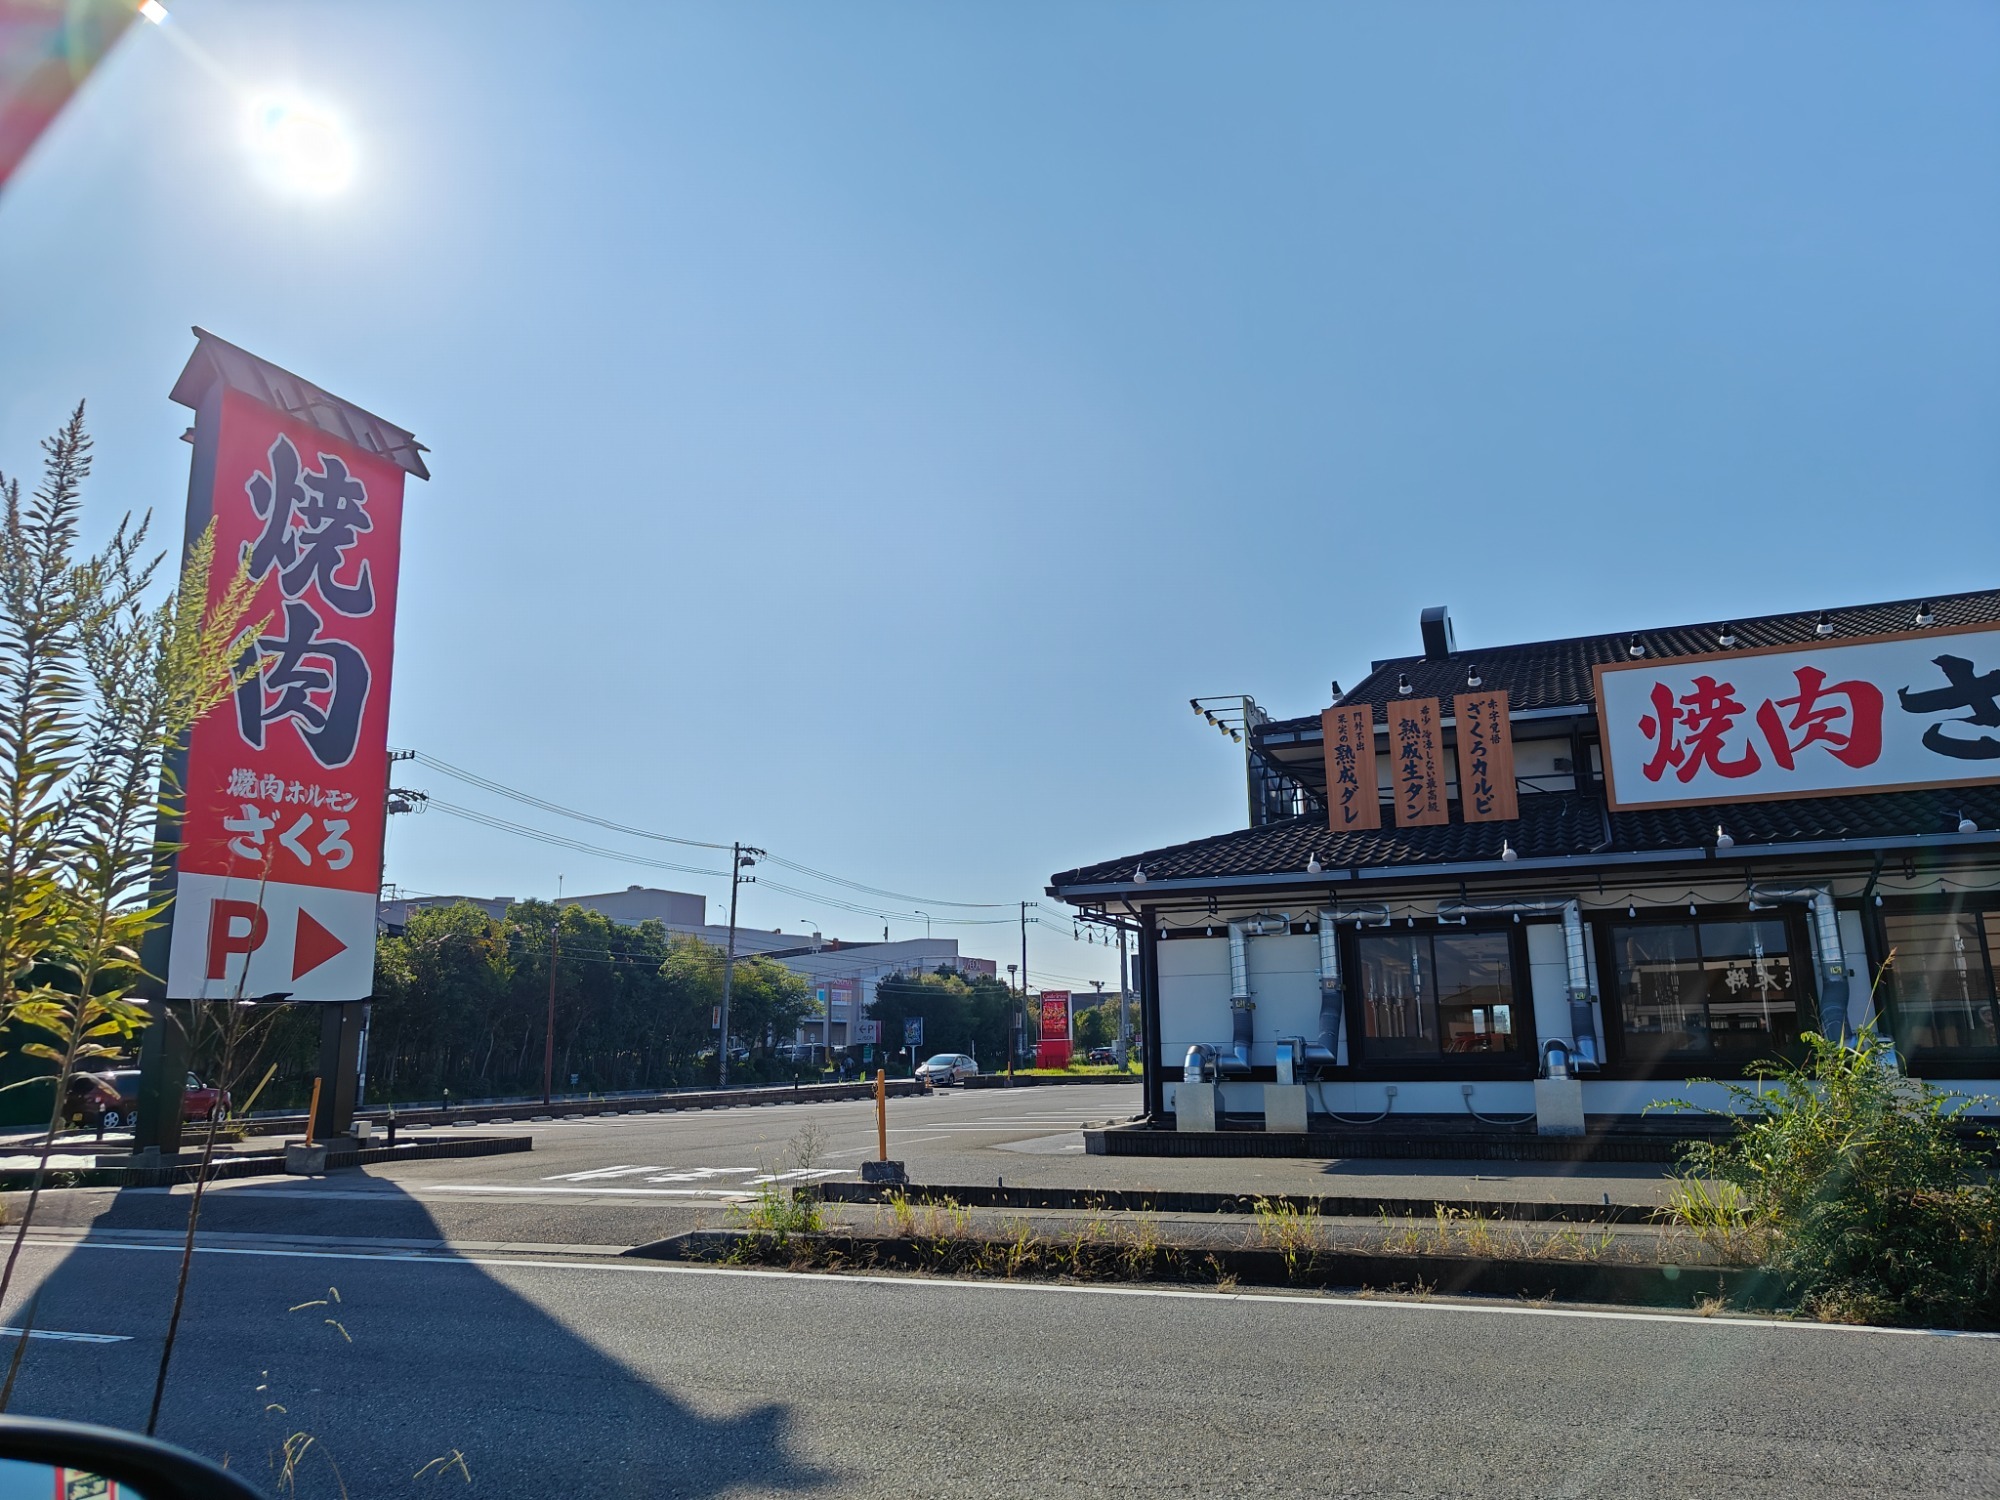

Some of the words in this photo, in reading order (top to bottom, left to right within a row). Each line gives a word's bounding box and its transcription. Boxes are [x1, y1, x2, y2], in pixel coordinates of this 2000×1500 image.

[229, 432, 376, 769] 焼肉
[1353, 711, 1365, 752] 門外不出
[1467, 700, 1494, 815] ざくろカルビ
[1487, 698, 1502, 745] 赤字覚悟
[226, 767, 359, 813] 焼肉ホルモン
[1398, 718, 1425, 820] 熟成生タン
[223, 803, 354, 871] ざくろ
[207, 899, 268, 980] P
